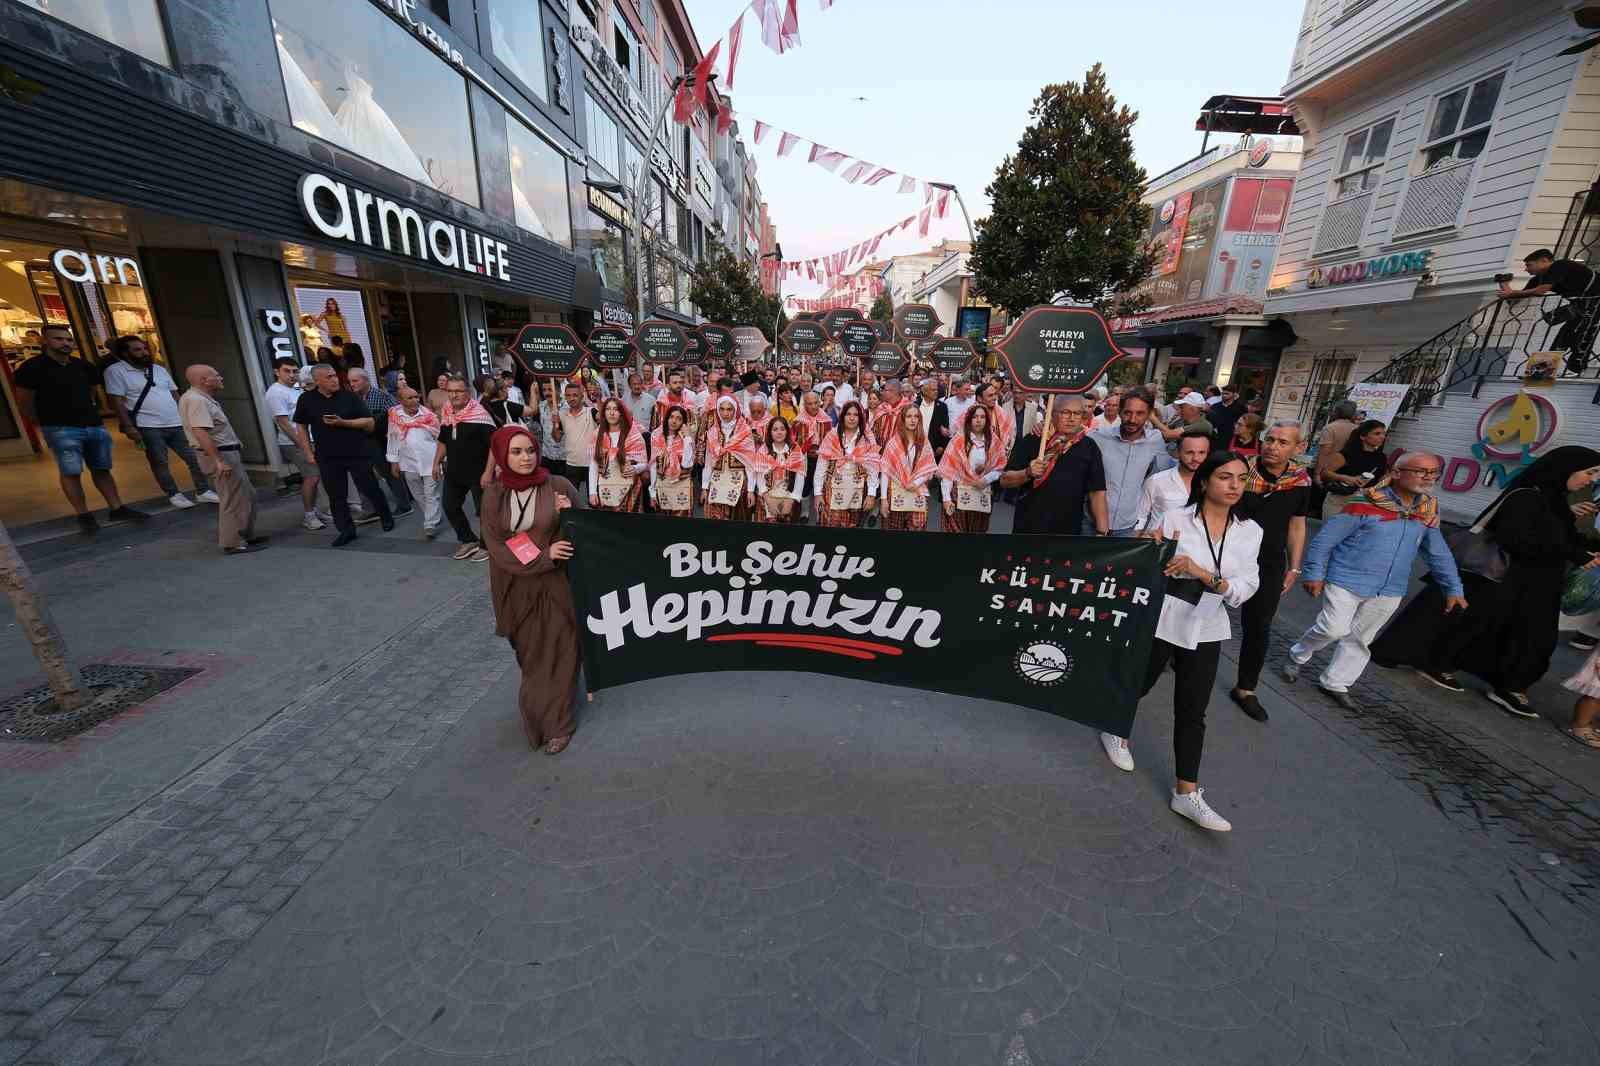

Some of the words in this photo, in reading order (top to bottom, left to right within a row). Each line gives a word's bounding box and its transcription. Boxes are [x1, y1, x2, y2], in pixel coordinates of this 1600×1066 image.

[1039, 329, 1085, 340] SAKARYA
[1045, 340, 1076, 349] YEREL
[662, 542, 733, 577] Bu
[741, 540, 876, 585] Şehir
[979, 566, 1150, 606] KÜLTÜR
[586, 575, 941, 651] Hepimizin
[990, 593, 1128, 628] SANAT
